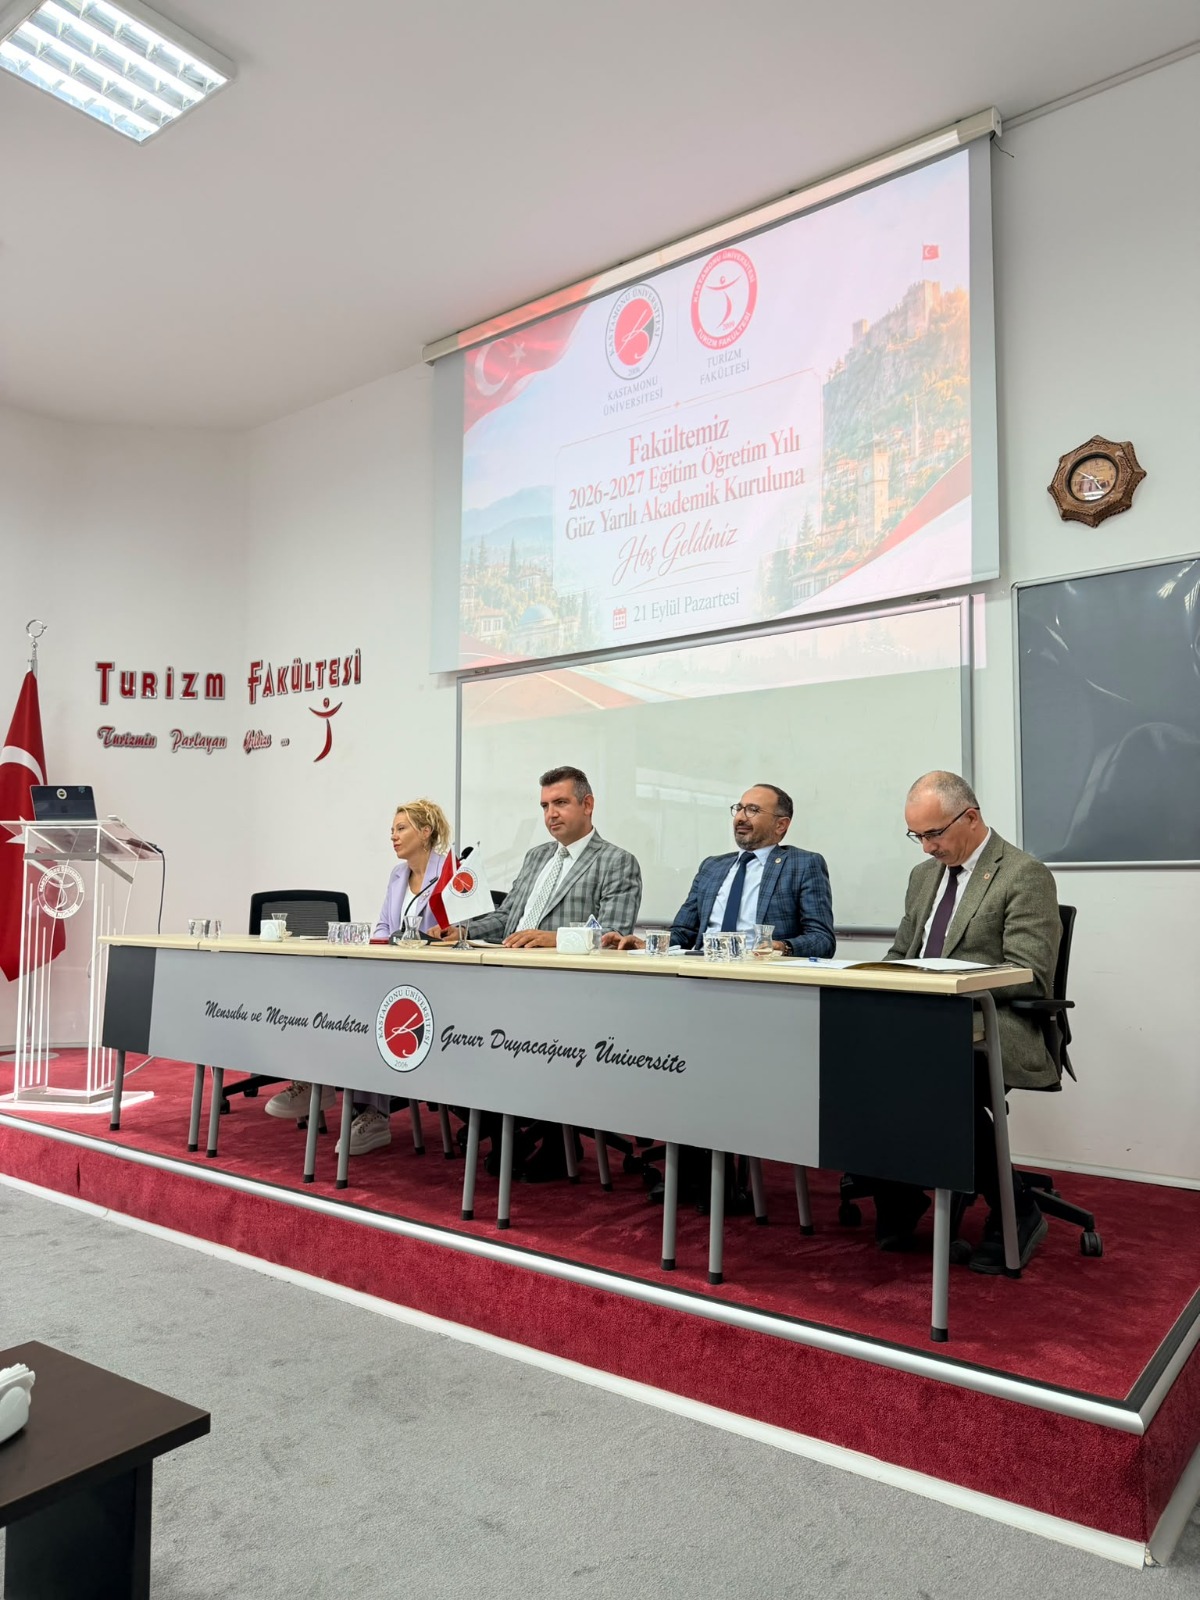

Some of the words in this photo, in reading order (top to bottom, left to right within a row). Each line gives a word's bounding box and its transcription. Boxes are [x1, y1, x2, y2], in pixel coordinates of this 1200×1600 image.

[607, 292, 631, 357] KASTAMONU
[700, 358, 750, 385] FAKÜLTESİ
[707, 348, 742, 369] TURİZM
[603, 386, 663, 416] ÜNİVERSİTESİ
[607, 375, 658, 401] KASTAMONU
[628, 414, 730, 466] Fakültemiz
[568, 470, 645, 510] 2026-2027
[649, 460, 697, 494] Eğitim
[701, 440, 767, 478] Öğretim
[770, 426, 801, 457] Yılı
[565, 515, 595, 541] Güz
[600, 503, 637, 533] Yarılı
[640, 481, 720, 524] Akademik
[724, 466, 806, 502] Kuruluna
[612, 534, 657, 586] Hoş
[657, 518, 739, 577] Geldiniz
[633, 606, 647, 622] 21
[651, 599, 681, 623] Eylül
[684, 587, 740, 613] Pazartesi
[97, 726, 157, 748] Turizmin
[170, 729, 227, 755] Parlayan
[204, 1000, 248, 1022] Mensubu
[250, 1011, 263, 1022] ve
[266, 1006, 309, 1032] Mezunu
[312, 1011, 370, 1034] Olmaktan
[377, 990, 403, 1039] KASTAMONU
[405, 987, 431, 1045] ÜNİVERSİTESİ
[440, 1024, 485, 1052] Gurur
[490, 1028, 588, 1068] Duyacağınız
[594, 1036, 687, 1074] Üniversite
